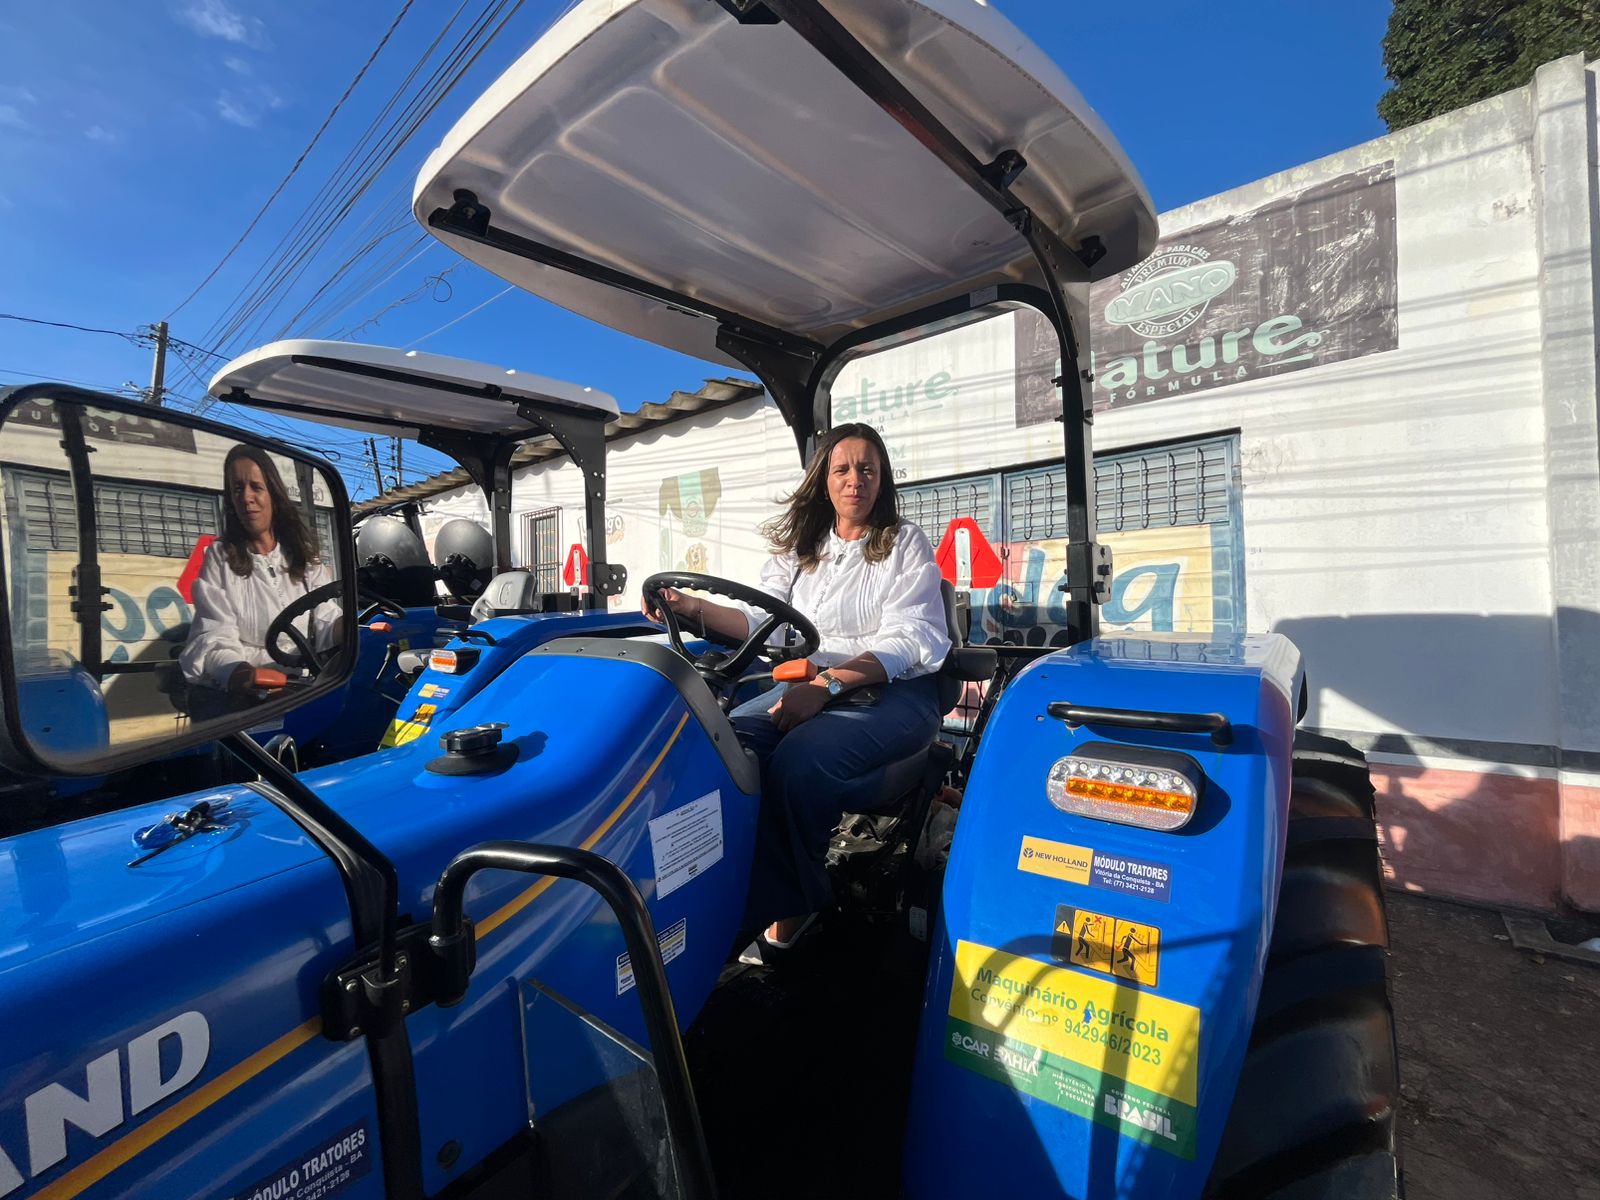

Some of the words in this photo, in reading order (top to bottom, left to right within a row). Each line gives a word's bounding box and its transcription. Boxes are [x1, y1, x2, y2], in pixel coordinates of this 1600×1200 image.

[1166, 244, 1191, 254] PARA
[1135, 256, 1193, 284] PREMIUM
[1136, 309, 1199, 336] ESPECIAL
[833, 371, 955, 422] ature
[1109, 365, 1248, 404] FÓRMULA
[1035, 851, 1052, 860] NEW
[1053, 856, 1088, 868] HOLLAND
[1094, 855, 1125, 872] MÓDULO
[1127, 862, 1168, 881] TRATORES
[1095, 868, 1112, 878] Vitória
[1121, 874, 1150, 886] Conquista
[1113, 880, 1125, 888] (77)
[976, 967, 1078, 1010] Maquinário
[1083, 999, 1169, 1042] Agrícola
[962, 1035, 990, 1057] CAR
[1064, 1018, 1161, 1065] 942946/2023
[1111, 1088, 1141, 1104] GOVERNO
[1142, 1101, 1171, 1116] FEDERAL
[1104, 1093, 1176, 1142] BRASIL
[302, 1128, 366, 1181] TRATORES
[296, 1164, 343, 1198] Conquista
[350, 1150, 363, 1164] BA
